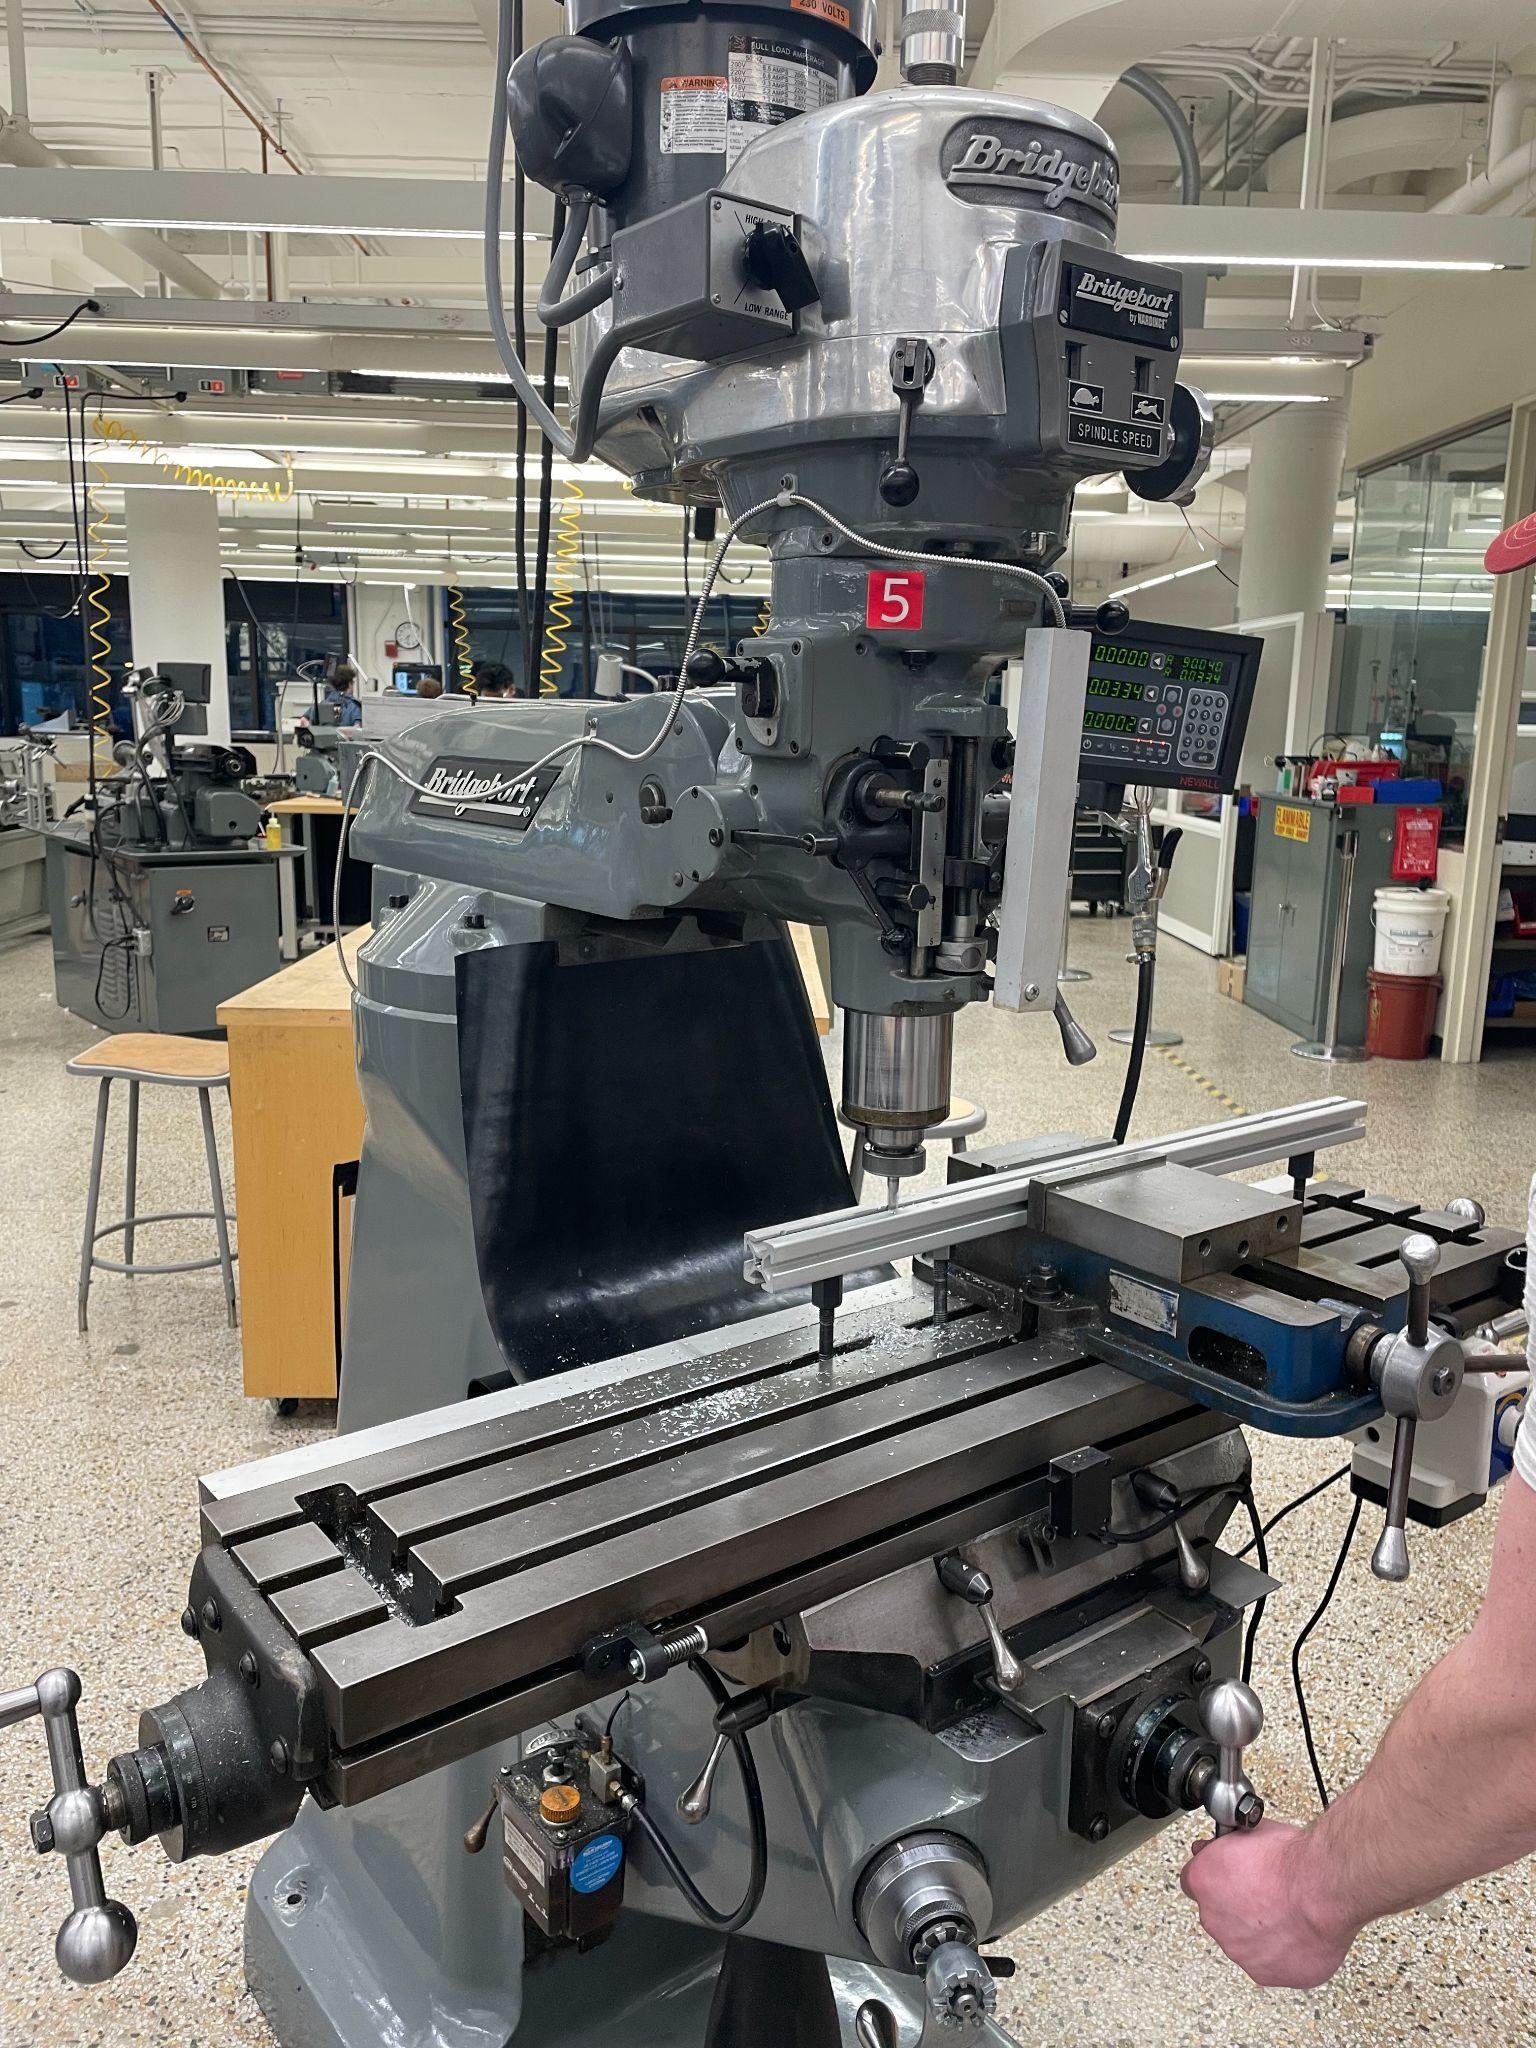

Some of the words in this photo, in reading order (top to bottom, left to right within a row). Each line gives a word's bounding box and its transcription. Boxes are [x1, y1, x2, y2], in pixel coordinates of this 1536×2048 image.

[822, 2, 845, 21] VOLTS
[771, 45, 791, 56] LOAD
[1077, 272, 1173, 312] Bridgeport
[744, 302, 761, 315] LOW
[764, 307, 789, 321] RANGE
[1129, 311, 1138, 326] by
[1078, 423, 1119, 443] SPINDLE
[1122, 430, 1152, 449] SPEED
[881, 578, 909, 623] 5
[1180, 776, 1220, 790] NEWALL
